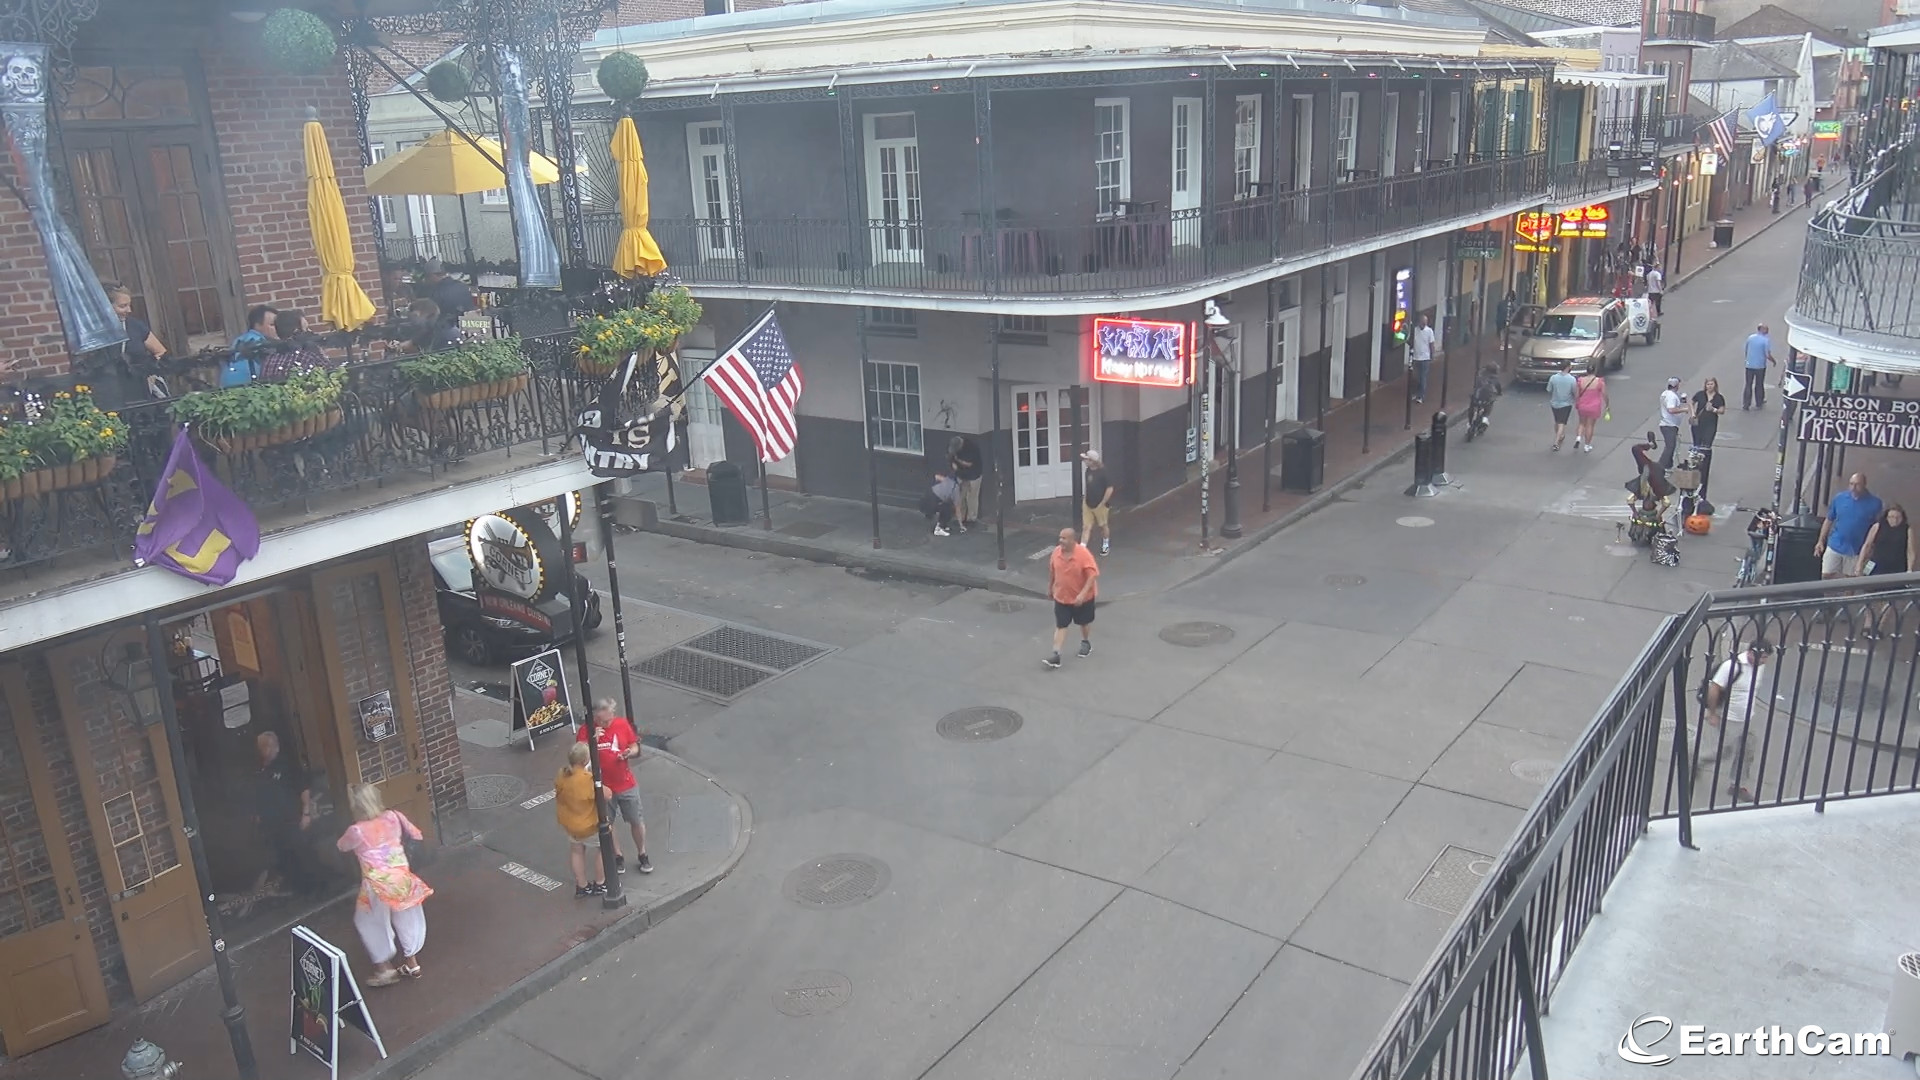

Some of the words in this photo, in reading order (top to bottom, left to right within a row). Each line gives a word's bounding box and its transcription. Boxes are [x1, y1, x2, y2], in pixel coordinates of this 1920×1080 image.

[1808, 395, 1881, 411] MAISON
[1820, 408, 1896, 423] DEDICATED
[489, 545, 526, 582] CORNET
[526, 605, 552, 627] CUISIN
[529, 668, 550, 684] CORNET
[302, 958, 324, 981] CORNET
